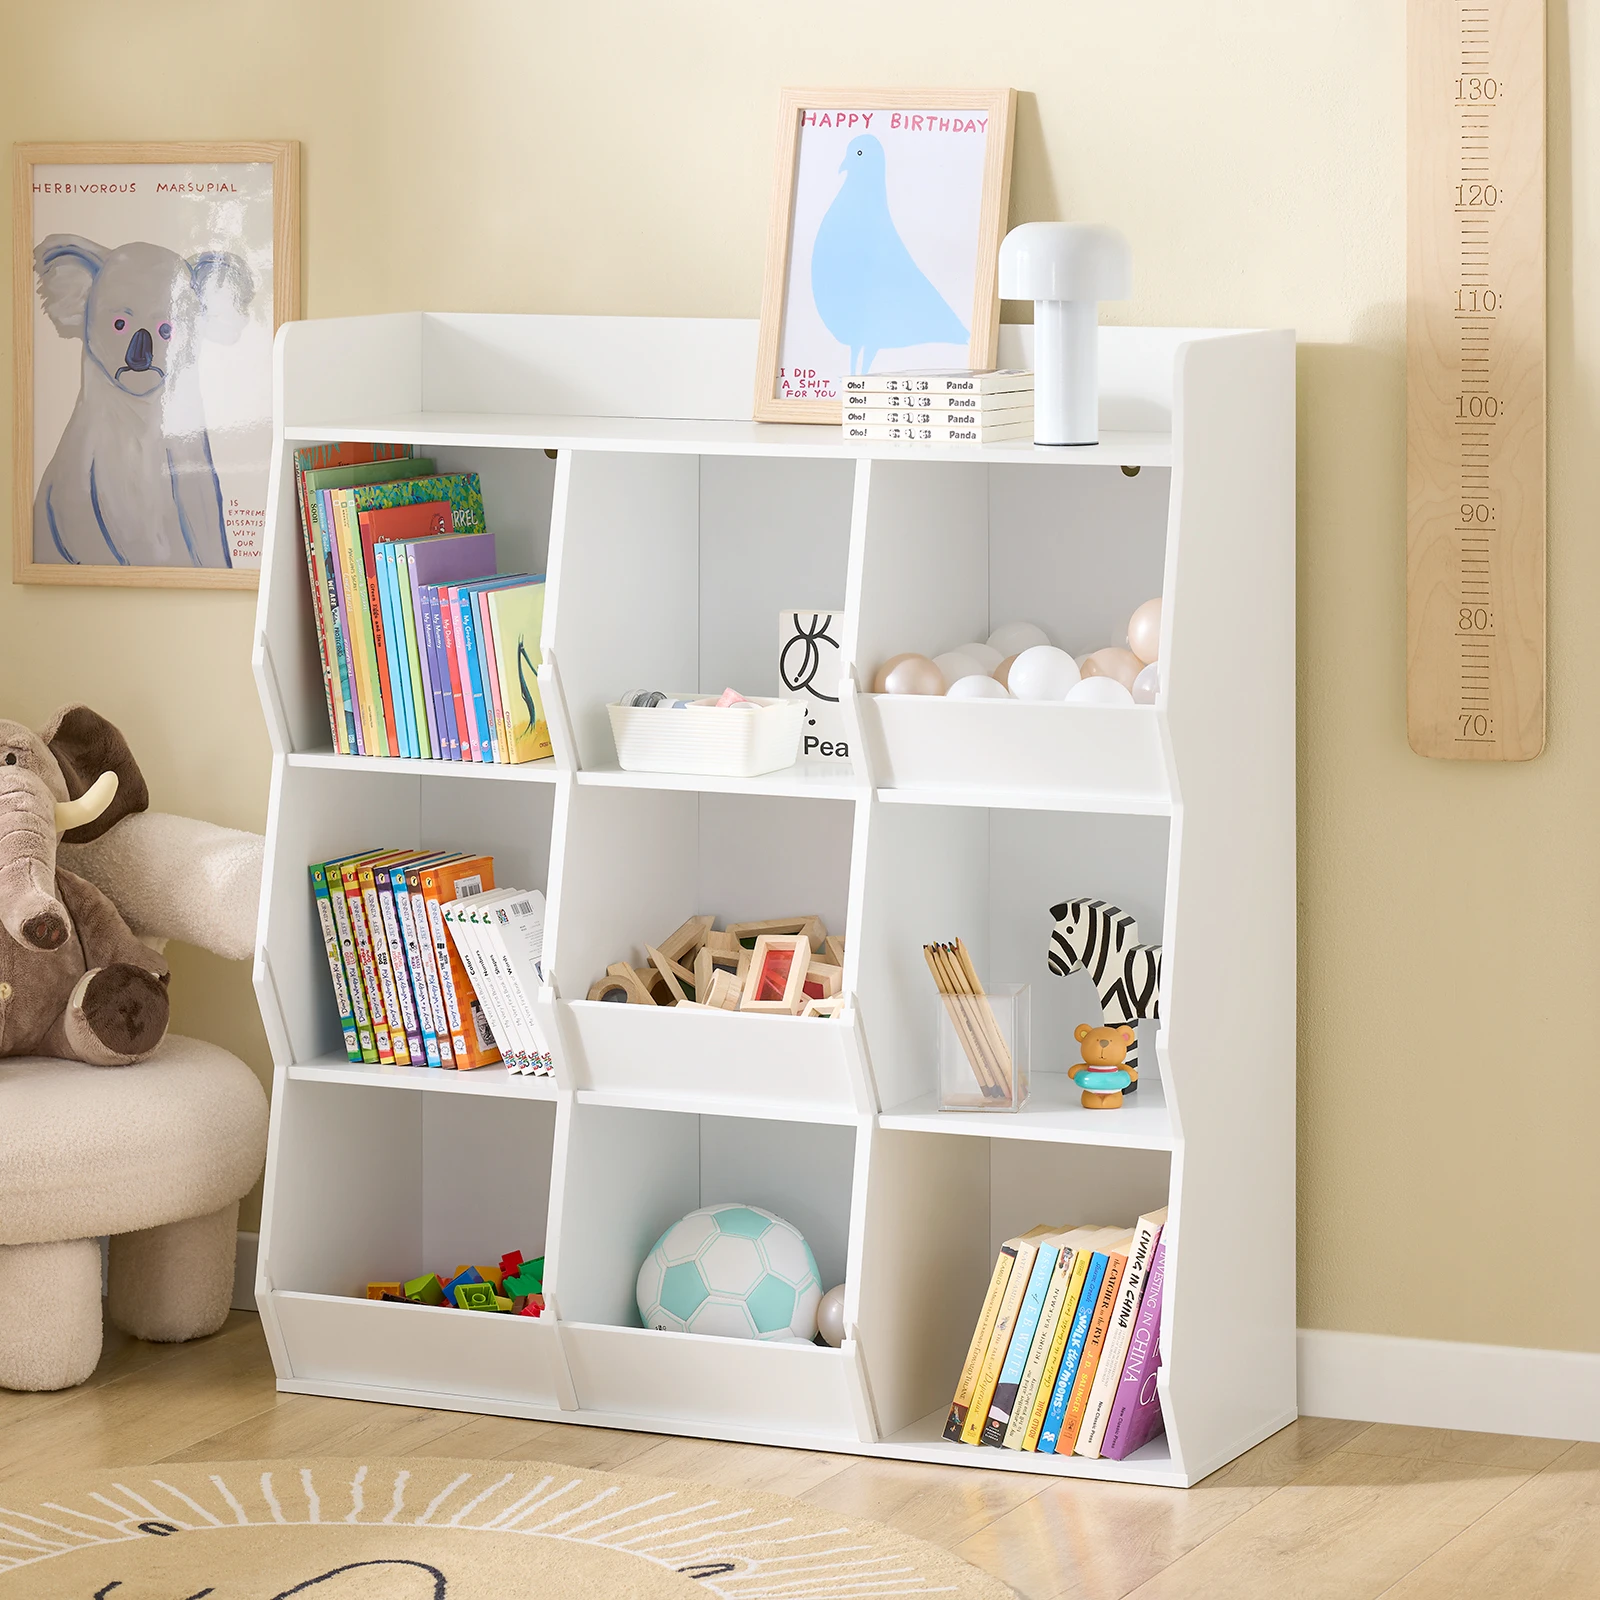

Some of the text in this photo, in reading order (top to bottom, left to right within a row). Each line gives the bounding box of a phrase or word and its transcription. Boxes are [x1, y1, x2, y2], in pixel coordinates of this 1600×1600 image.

[801, 111, 988, 133] HAPPY BIRTHDAY
[32, 182, 237, 194] HERBIVOROUS MARSUPIAL
[794, 369, 816, 379] DID
[782, 379, 830, 389] A SHIT
[848, 381, 974, 391] Oho! Panda
[786, 390, 836, 398] FOR YOU
[850, 396, 976, 408] Oho! Panda
[848, 413, 975, 424] Oho! Panda
[850, 429, 977, 440] Oho! Panda
[310, 503, 319, 523] Soon
[226, 519, 266, 528] DISSATIS
[234, 530, 256, 538] WITH
[237, 540, 254, 548] OUR
[327, 579, 334, 590] WE
[424, 613, 430, 623] My
[434, 614, 440, 624] My
[444, 619, 449, 629] My
[463, 615, 469, 625] My
[804, 736, 849, 757] Pea
[463, 954, 476, 976] Colors
[474, 949, 489, 977] Numbers
[488, 954, 501, 975] Shapes
[501, 954, 513, 975] Words
[1034, 1251, 1051, 1288] ESSAYS
[1112, 1258, 1121, 1269] the
[1116, 1229, 1151, 1328] LIVING IN CHINA
[1146, 1250, 1169, 1309] INVESTING
[1100, 1268, 1119, 1309] CATCHER
[1029, 1292, 1041, 1304] of
[1096, 1316, 1104, 1327] the
[1141, 1311, 1153, 1326] IN
[1033, 1288, 1060, 1364] FREDRIK BACKMAN
[1090, 1327, 1103, 1346] RYE
[1007, 1330, 1029, 1376] WHITE
[1123, 1326, 1152, 1385] CHINA
[1052, 1313, 1089, 1408] WALK two moons
[1071, 1350, 1094, 1413] J. D. SALINGER
[1027, 1399, 1045, 1438] ROALD DAHL
[1091, 1412, 1100, 1429] Classic
[1114, 1417, 1122, 1435] Classic
[1087, 1429, 1095, 1443] Press
[1110, 1435, 1118, 1449] Press
